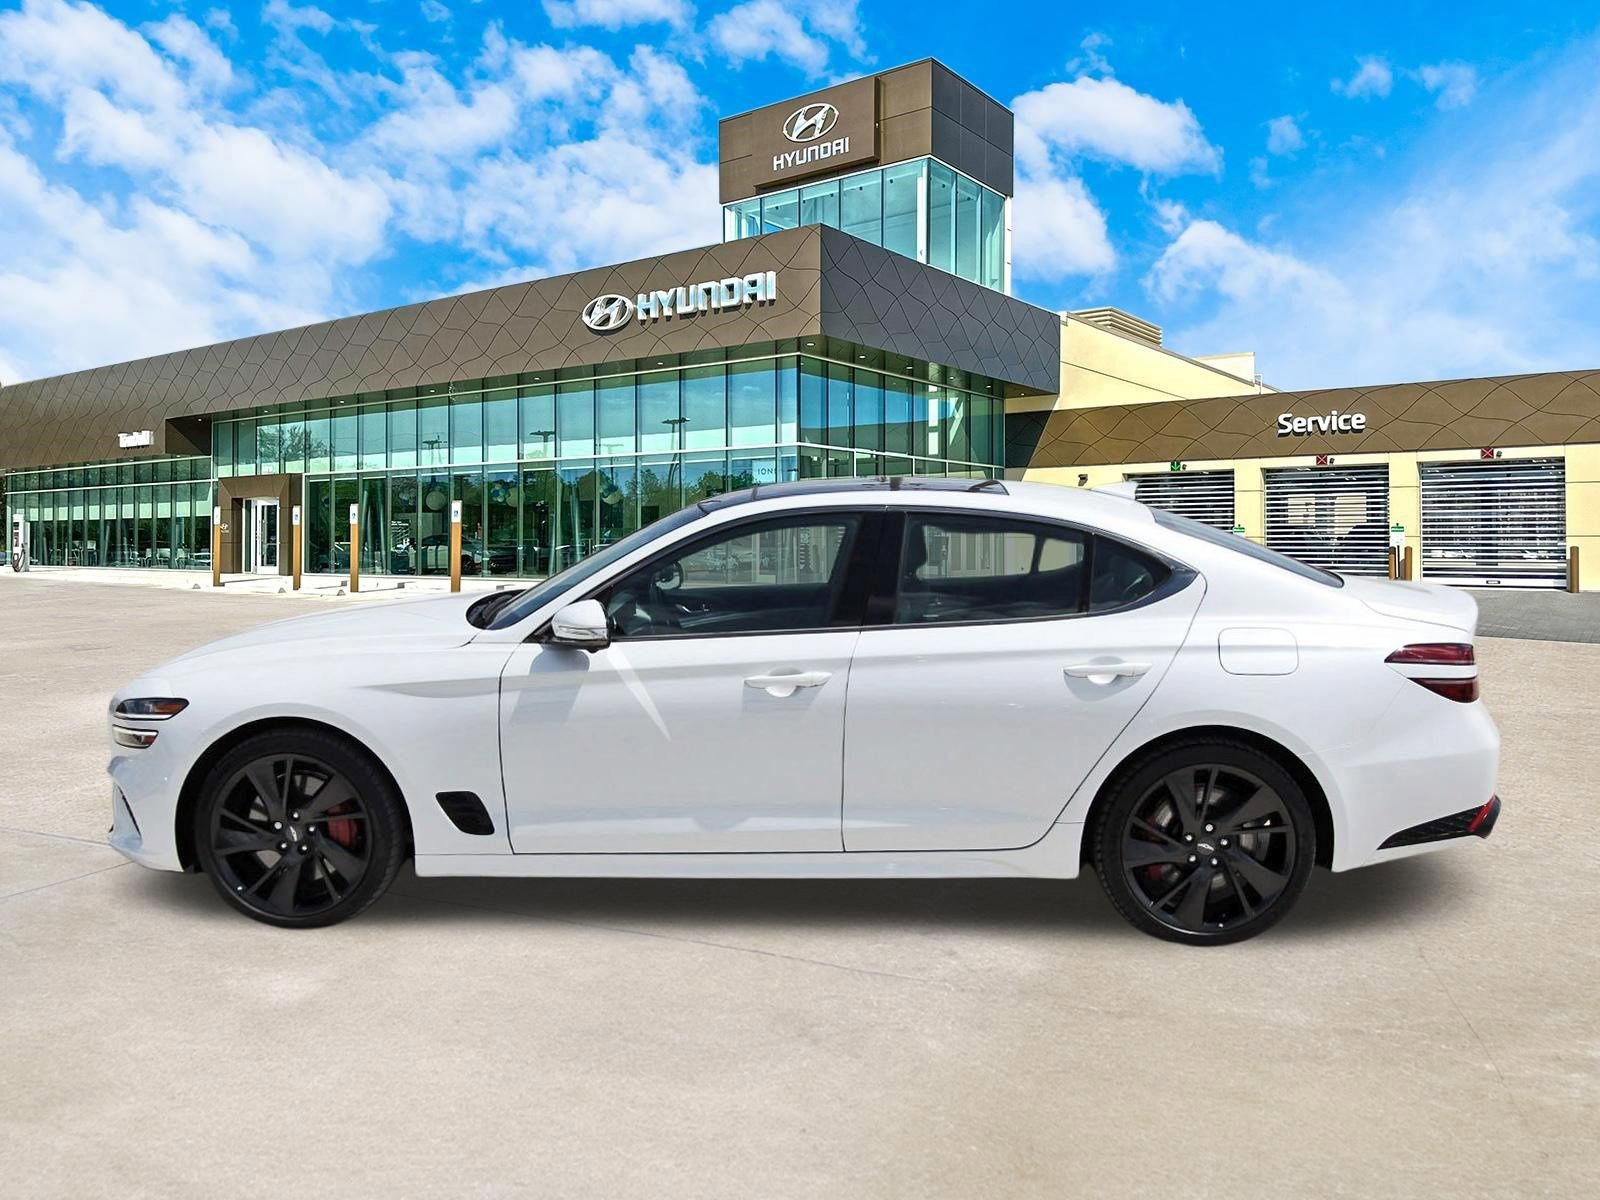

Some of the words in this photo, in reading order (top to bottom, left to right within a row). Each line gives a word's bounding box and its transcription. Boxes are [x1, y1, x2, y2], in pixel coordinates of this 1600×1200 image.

[773, 136, 850, 171] HYUNDAI
[637, 270, 777, 322] HYUNDAI
[1277, 410, 1367, 434] Service
